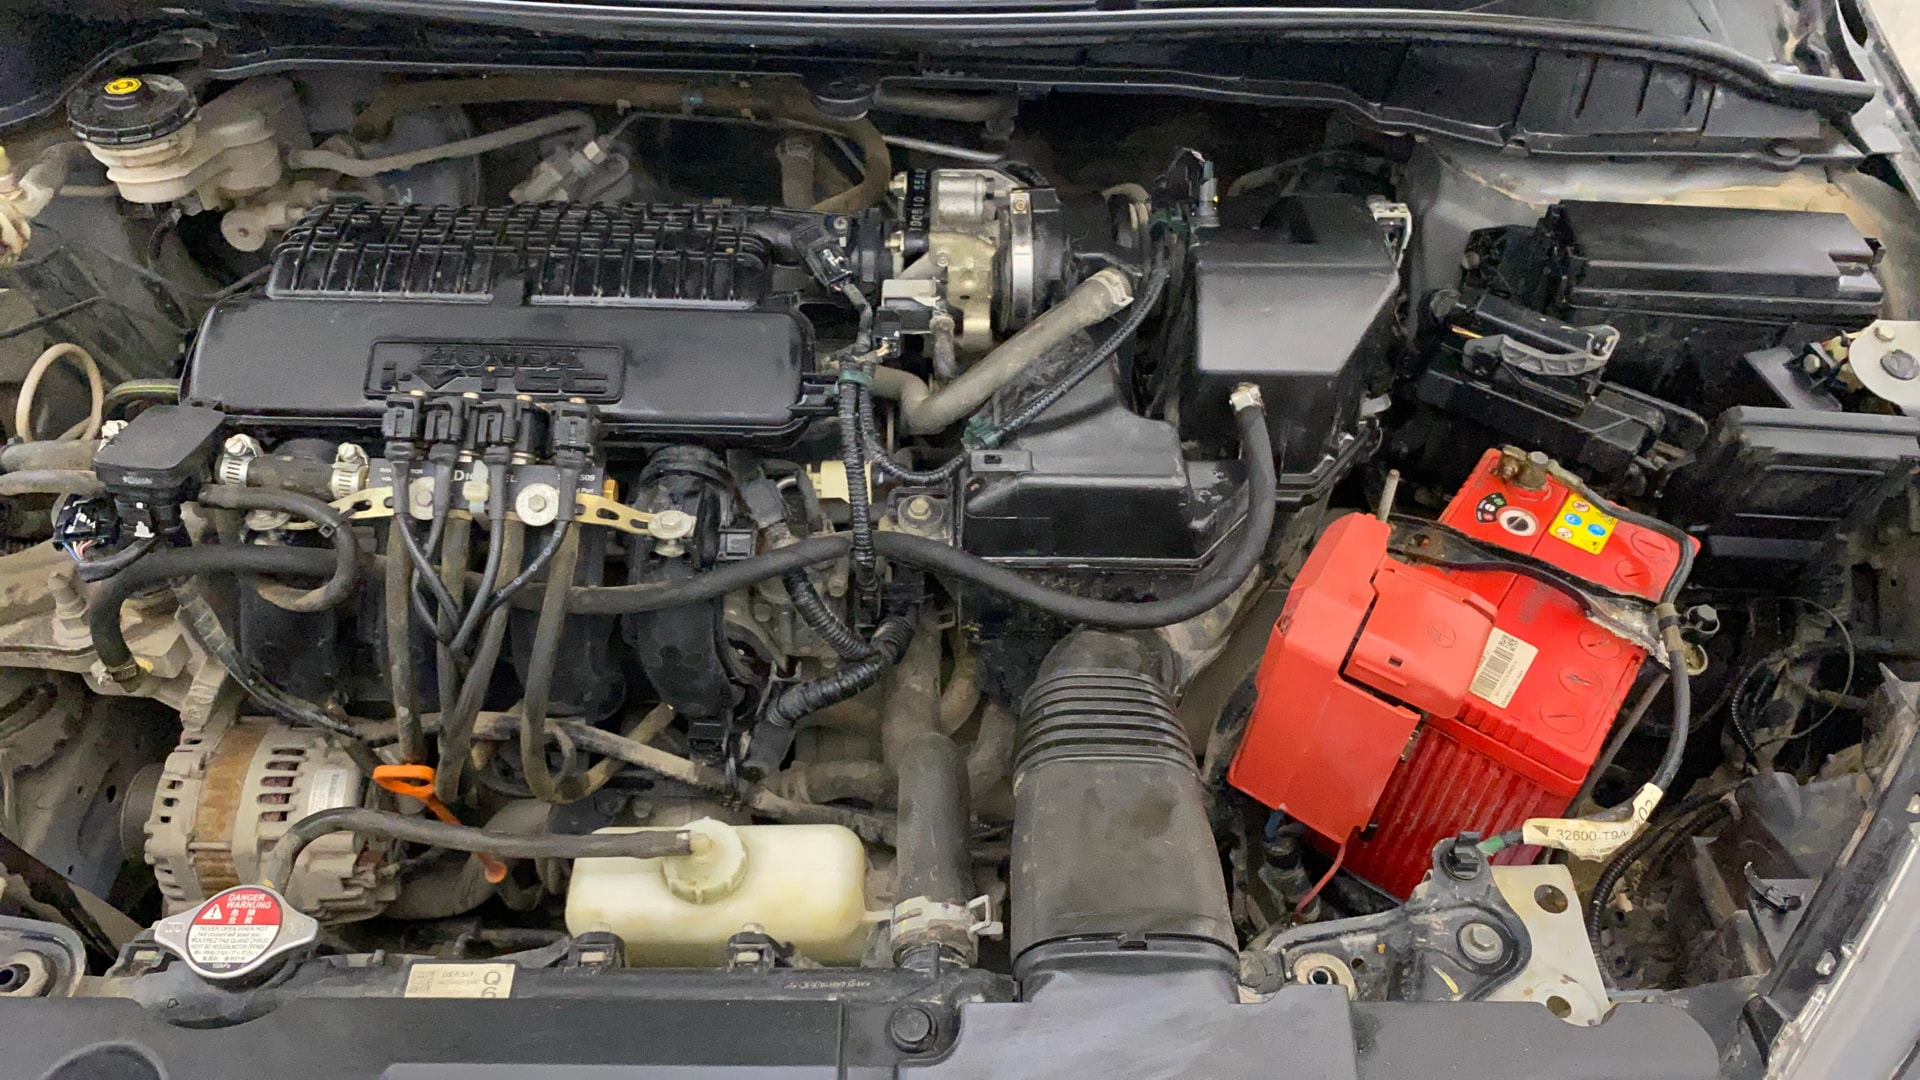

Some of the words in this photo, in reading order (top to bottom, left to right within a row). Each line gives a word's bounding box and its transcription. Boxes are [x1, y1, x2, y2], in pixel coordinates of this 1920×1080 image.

[417, 345, 584, 368] HONDA
[228, 893, 266, 902] DANGER
[226, 900, 272, 909] WARNUNG
[441, 970, 474, 978] DENSO
[483, 970, 502, 986] Q
